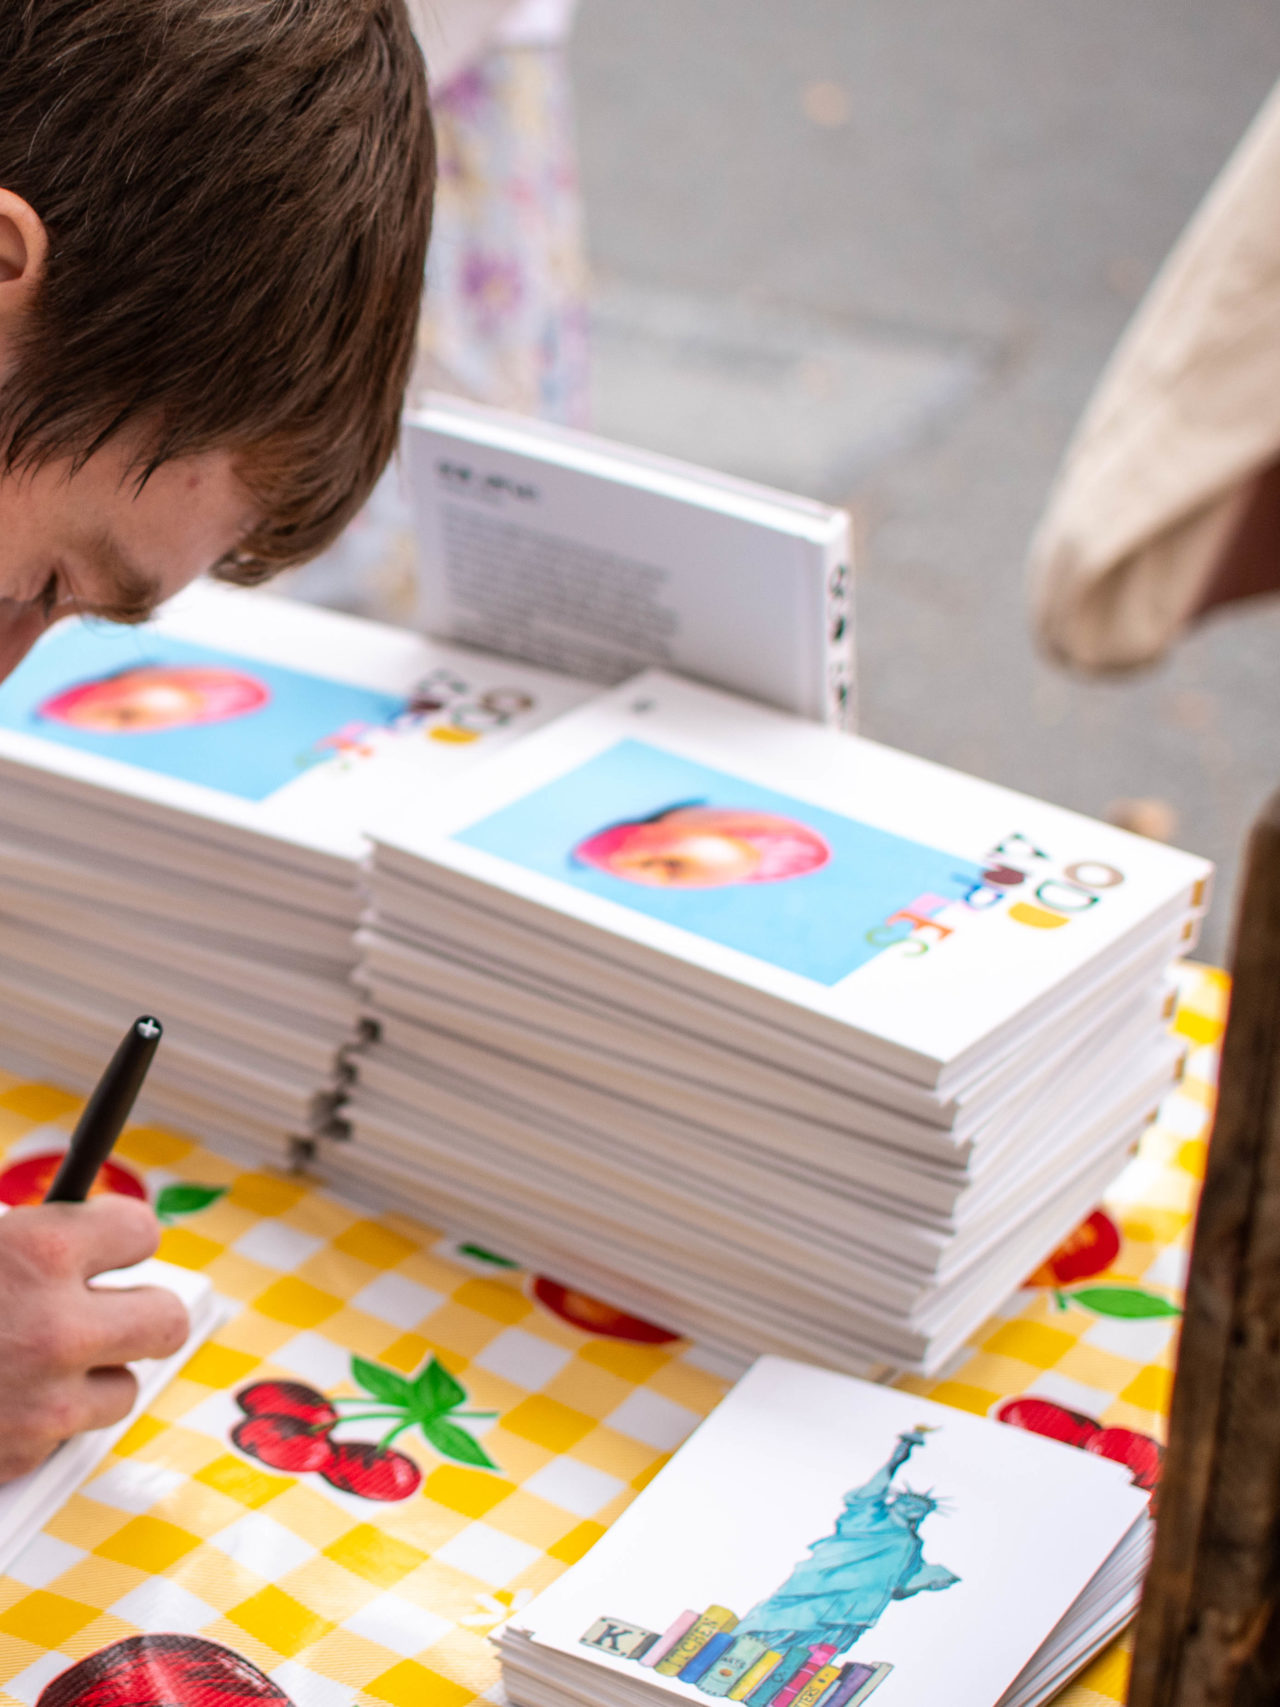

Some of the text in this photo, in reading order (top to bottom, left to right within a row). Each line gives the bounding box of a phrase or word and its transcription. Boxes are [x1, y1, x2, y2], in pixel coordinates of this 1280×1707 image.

[865, 832, 1050, 957] APPLES
[1008, 861, 1125, 930] ODD
[592, 1624, 633, 1651] K
